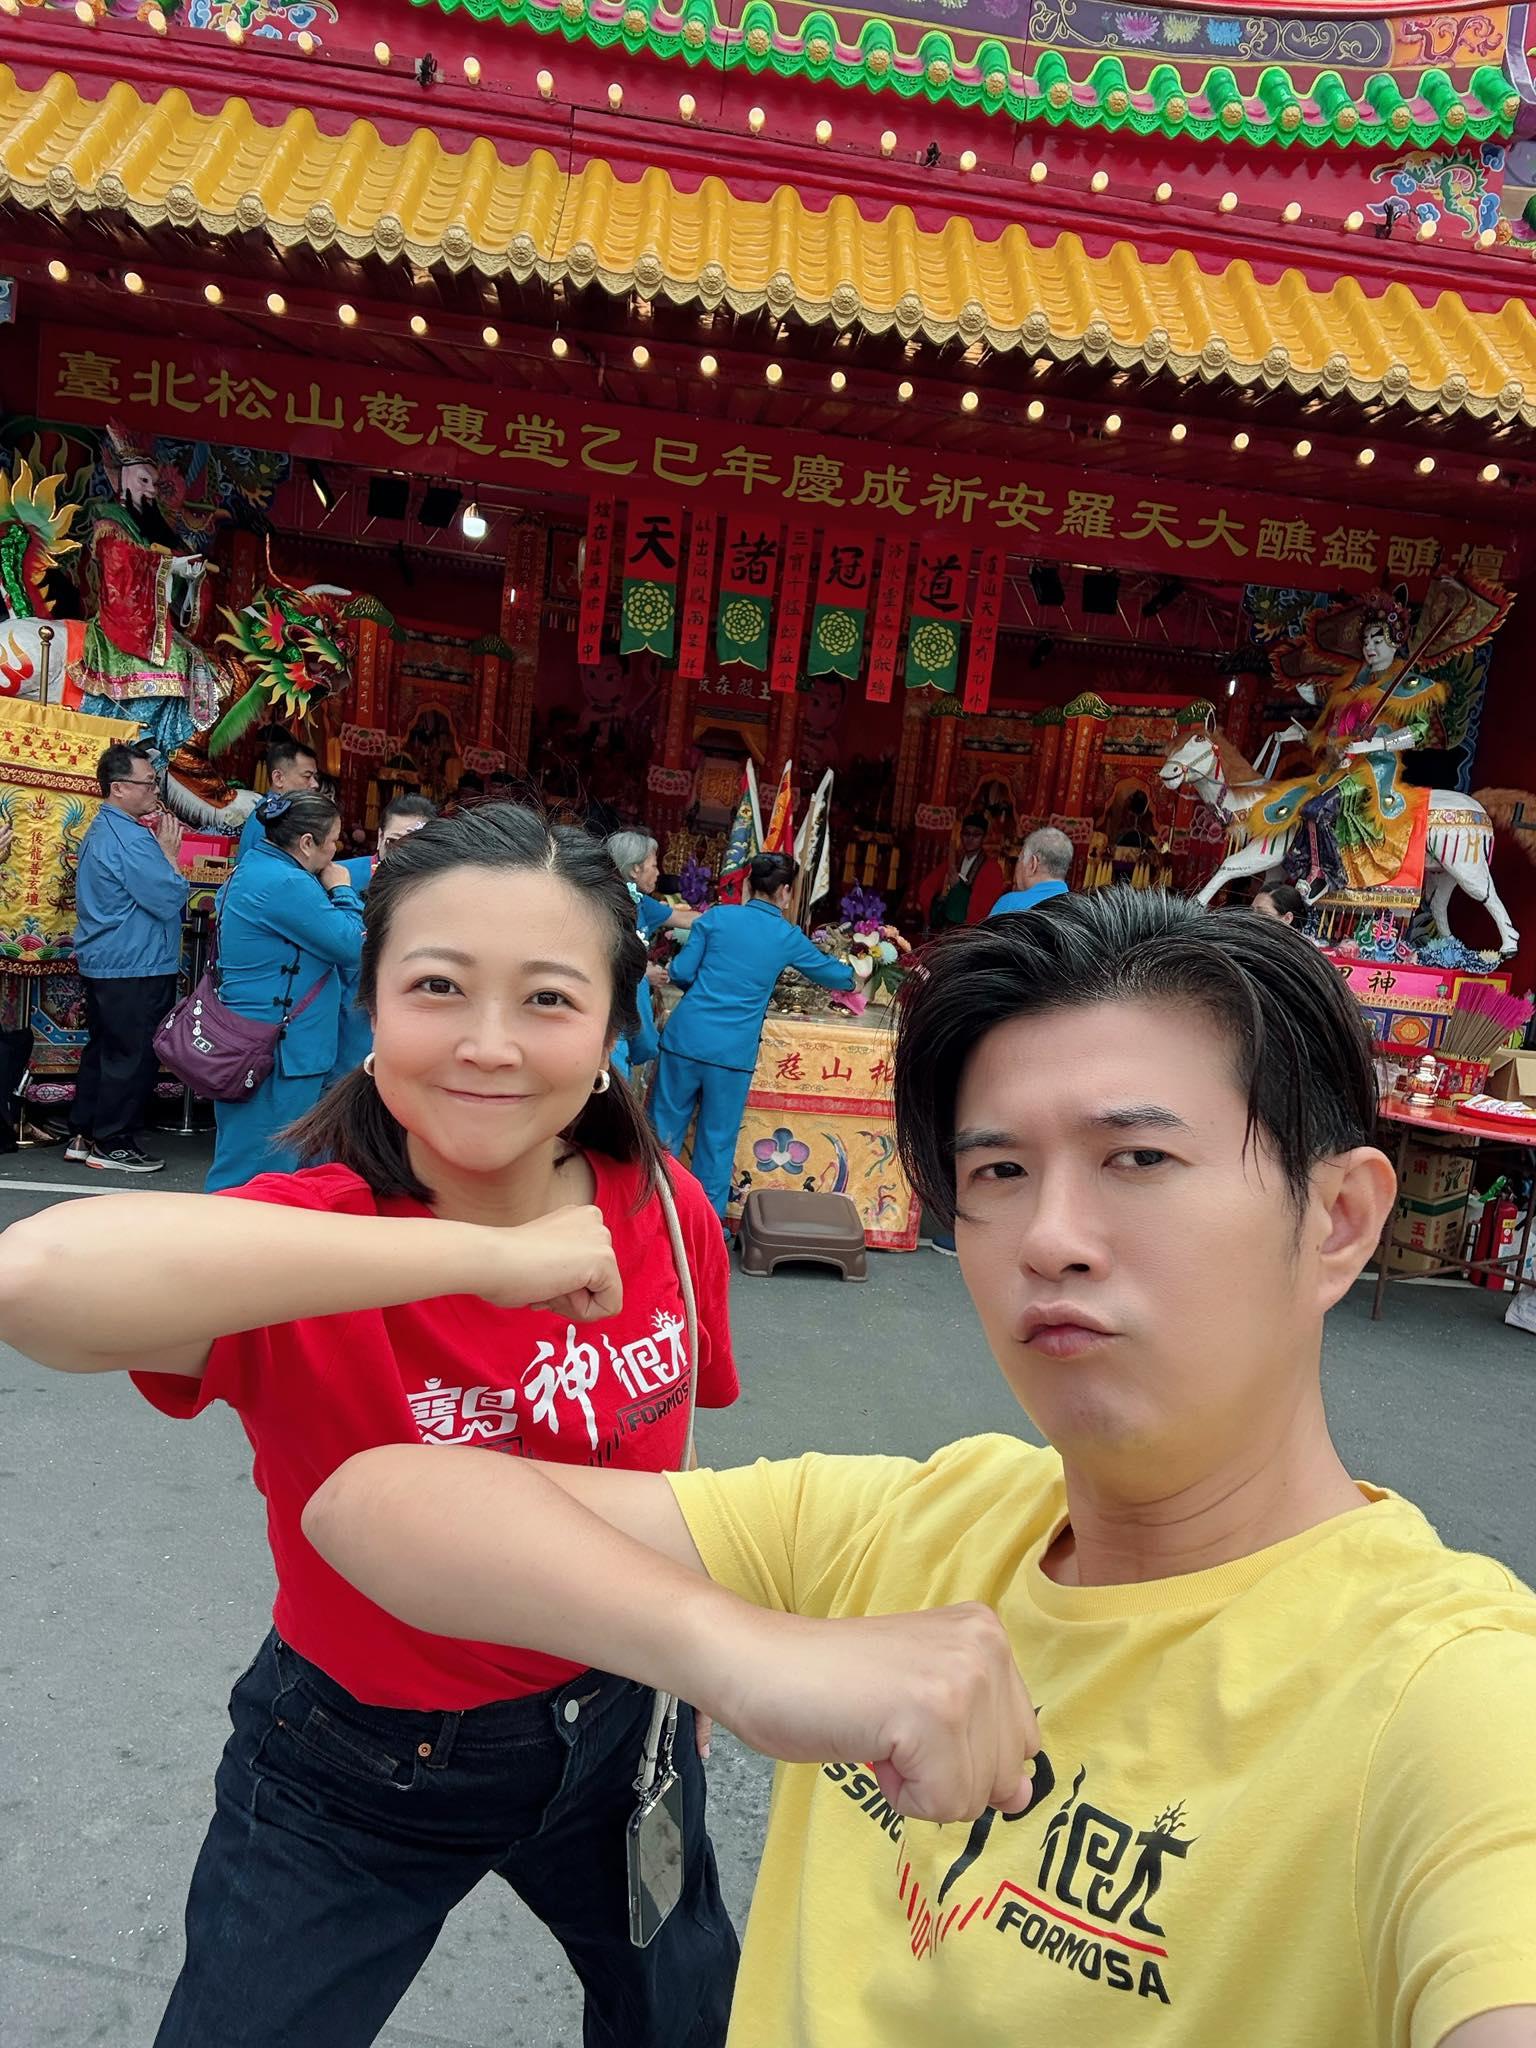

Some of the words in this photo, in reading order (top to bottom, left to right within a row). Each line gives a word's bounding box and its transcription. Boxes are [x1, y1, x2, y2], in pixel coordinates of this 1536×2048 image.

[629, 516, 677, 569] 天
[729, 530, 777, 586] 諸
[824, 545, 867, 591] 冠
[918, 553, 963, 612] 道
[625, 1381, 690, 1434] FORMOS
[994, 1900, 1172, 2006] FORMOSA
